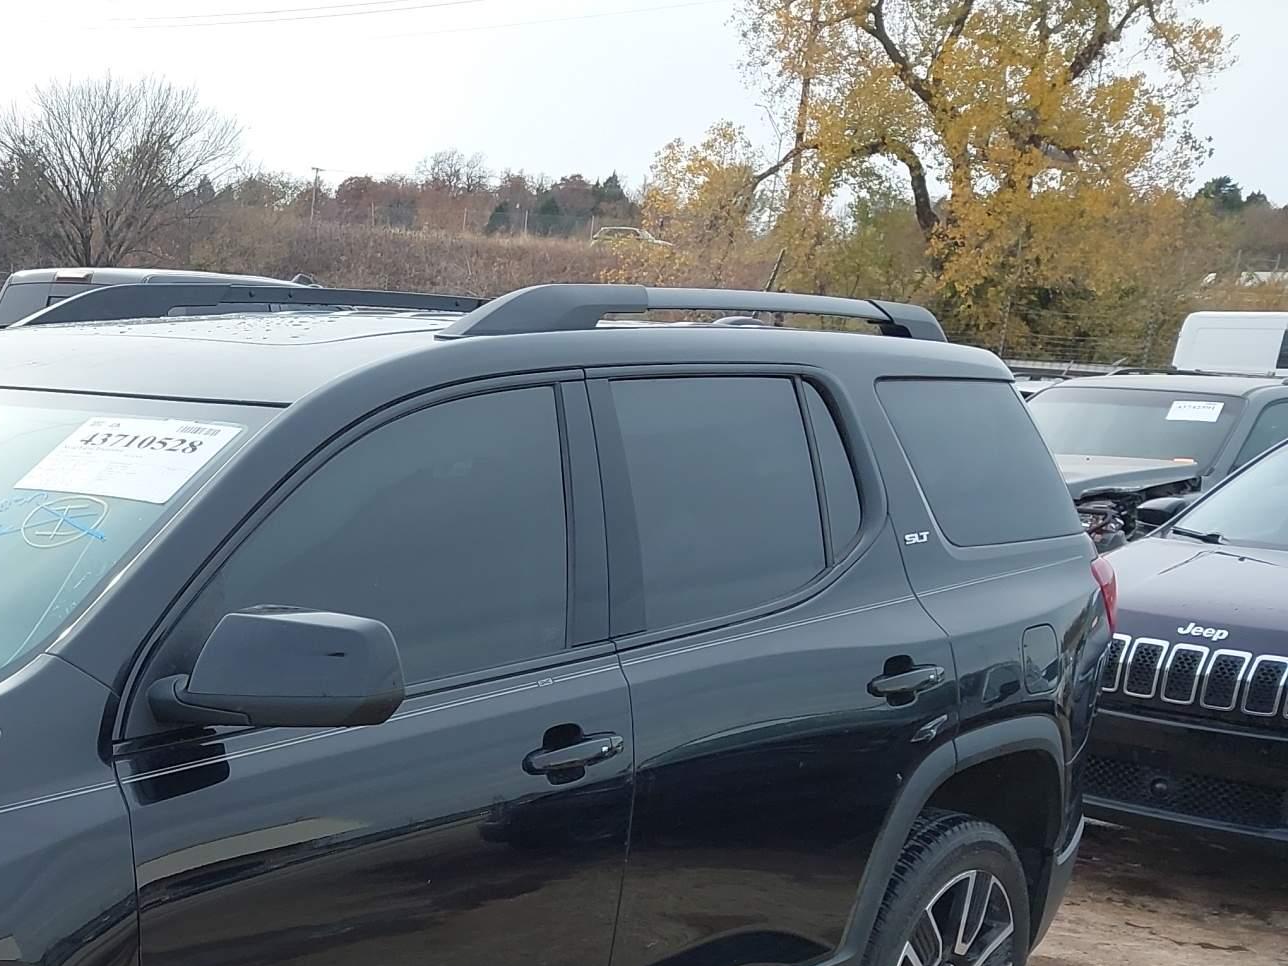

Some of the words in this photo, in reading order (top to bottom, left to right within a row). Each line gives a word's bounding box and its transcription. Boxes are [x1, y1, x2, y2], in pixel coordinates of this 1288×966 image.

[79, 431, 204, 455] 43710528
[904, 531, 930, 545] SLT
[1177, 622, 1229, 642] Jeep
